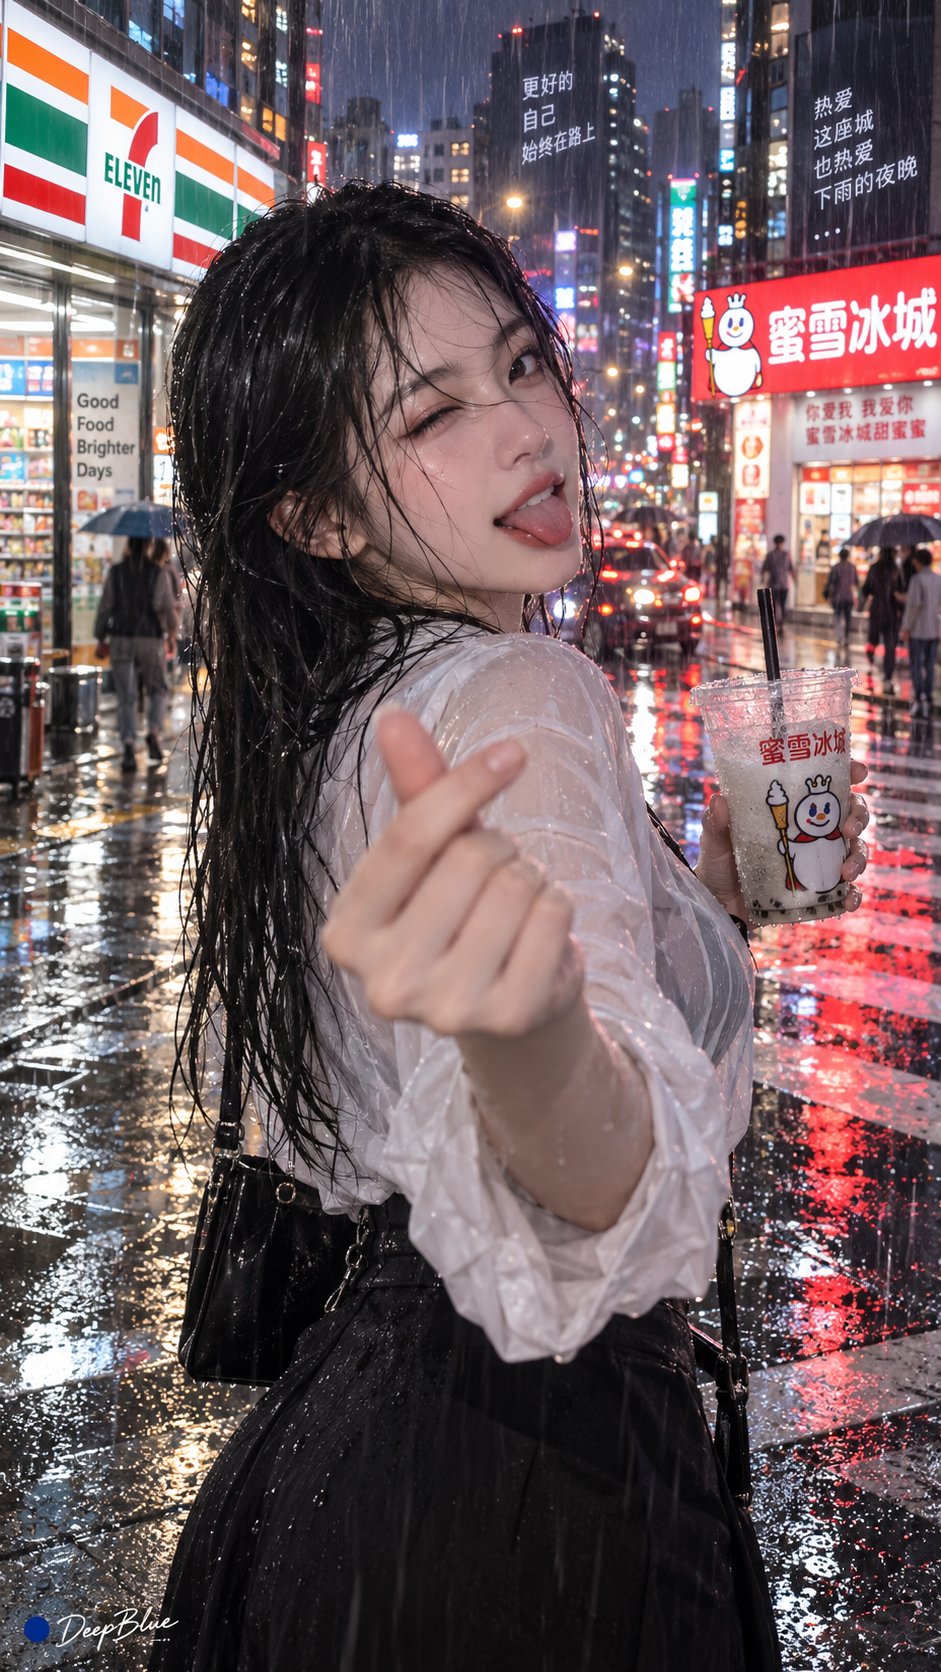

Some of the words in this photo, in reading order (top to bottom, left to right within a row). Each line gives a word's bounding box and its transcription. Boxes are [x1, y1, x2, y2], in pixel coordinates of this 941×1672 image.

[522, 70, 573, 100] 更好的
[523, 103, 556, 133] 自己
[814, 87, 853, 120] 热爱
[521, 121, 596, 165] 始终在路上
[814, 109, 874, 150] 这座城
[110, 85, 158, 242] 7
[814, 138, 874, 180] 也热爱
[814, 155, 918, 210] 下雨的夜晚
[768, 287, 938, 365] 蜜雪冰城
[77, 393, 119, 409] Good
[861, 395, 914, 418] 我爱你
[77, 416, 114, 432] Food
[806, 419, 926, 446] 蜜雪冰城甜蜜蜜
[77, 439, 136, 458] Brighter
[77, 462, 113, 481] Days
[758, 728, 847, 766] 蜜雪冰城
